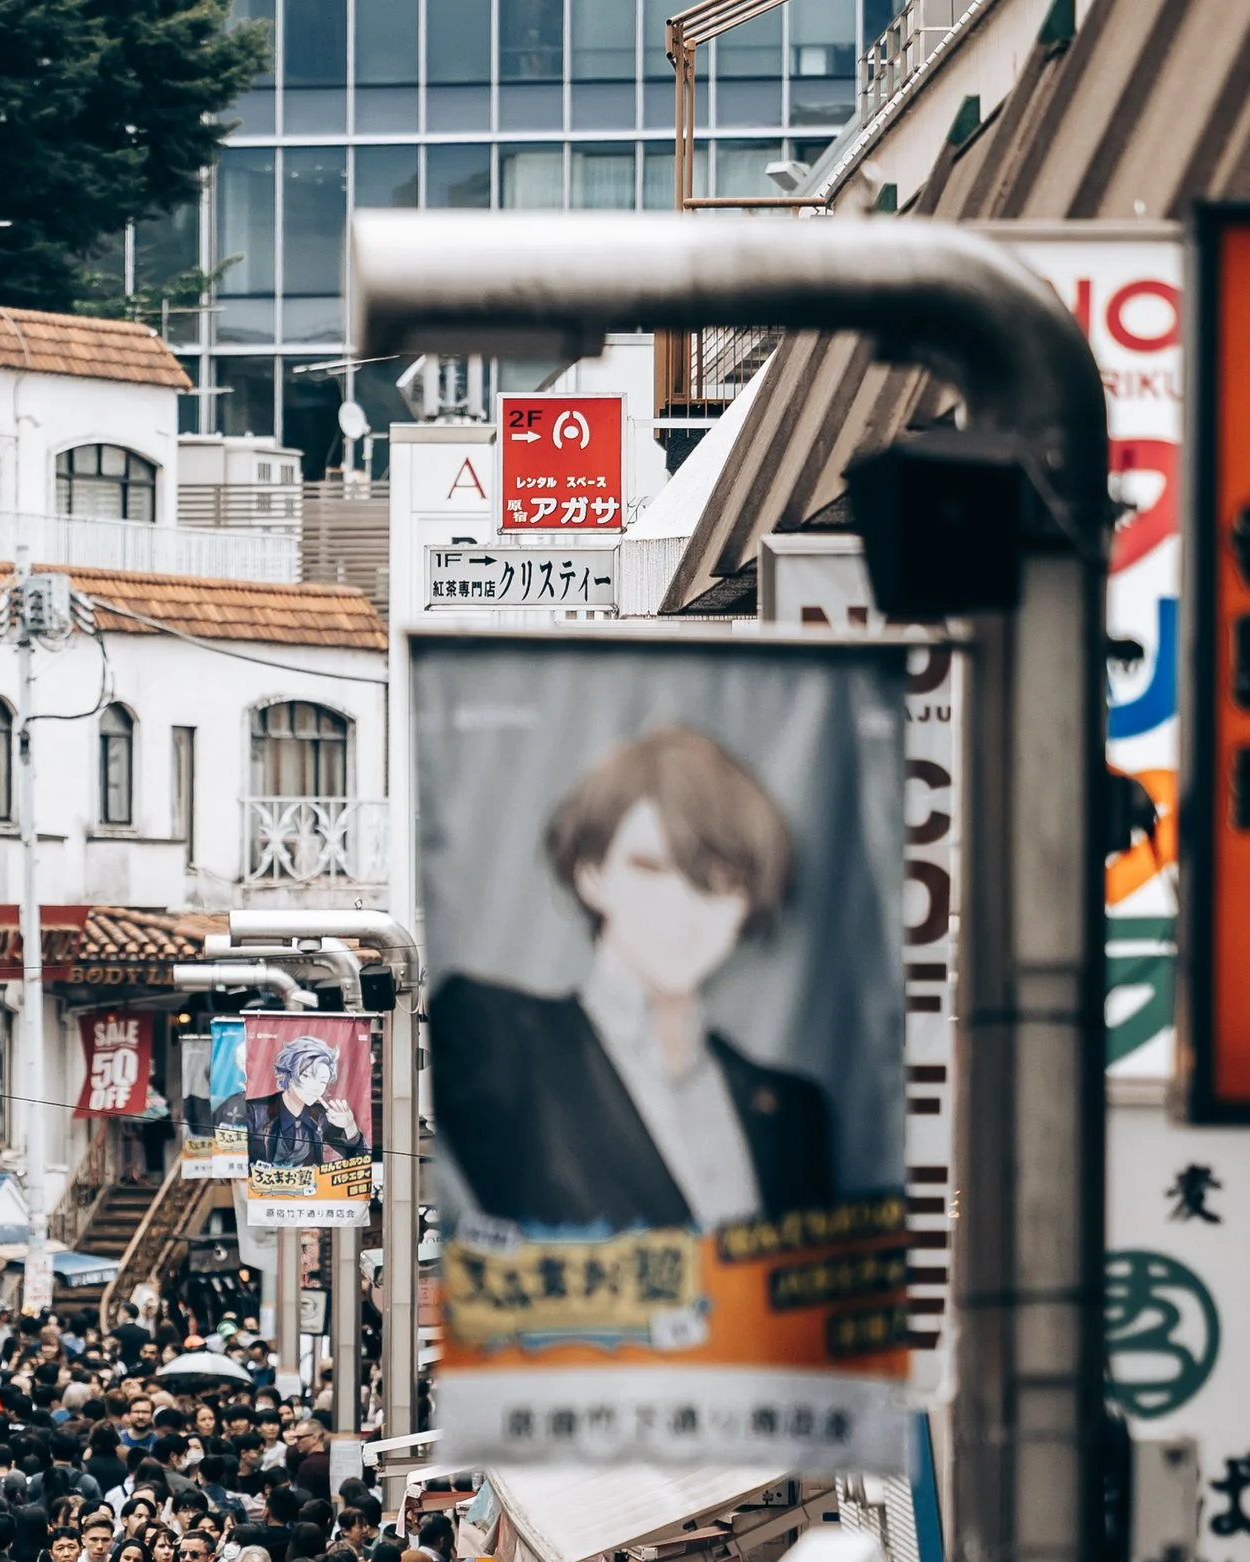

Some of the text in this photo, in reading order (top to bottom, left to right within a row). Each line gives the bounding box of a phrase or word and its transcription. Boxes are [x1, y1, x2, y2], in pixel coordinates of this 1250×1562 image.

[509, 410, 543, 427] 2F
[516, 476, 607, 488] レンタル スペース
[529, 496, 620, 524] アガサ
[435, 553, 462, 568] 1F
[432, 580, 496, 598] 紅茶専門店
[497, 560, 611, 602] クリスティー
[94, 1020, 139, 1047] SALE
[90, 1048, 139, 1091] 50
[89, 1086, 131, 1110] OFF
